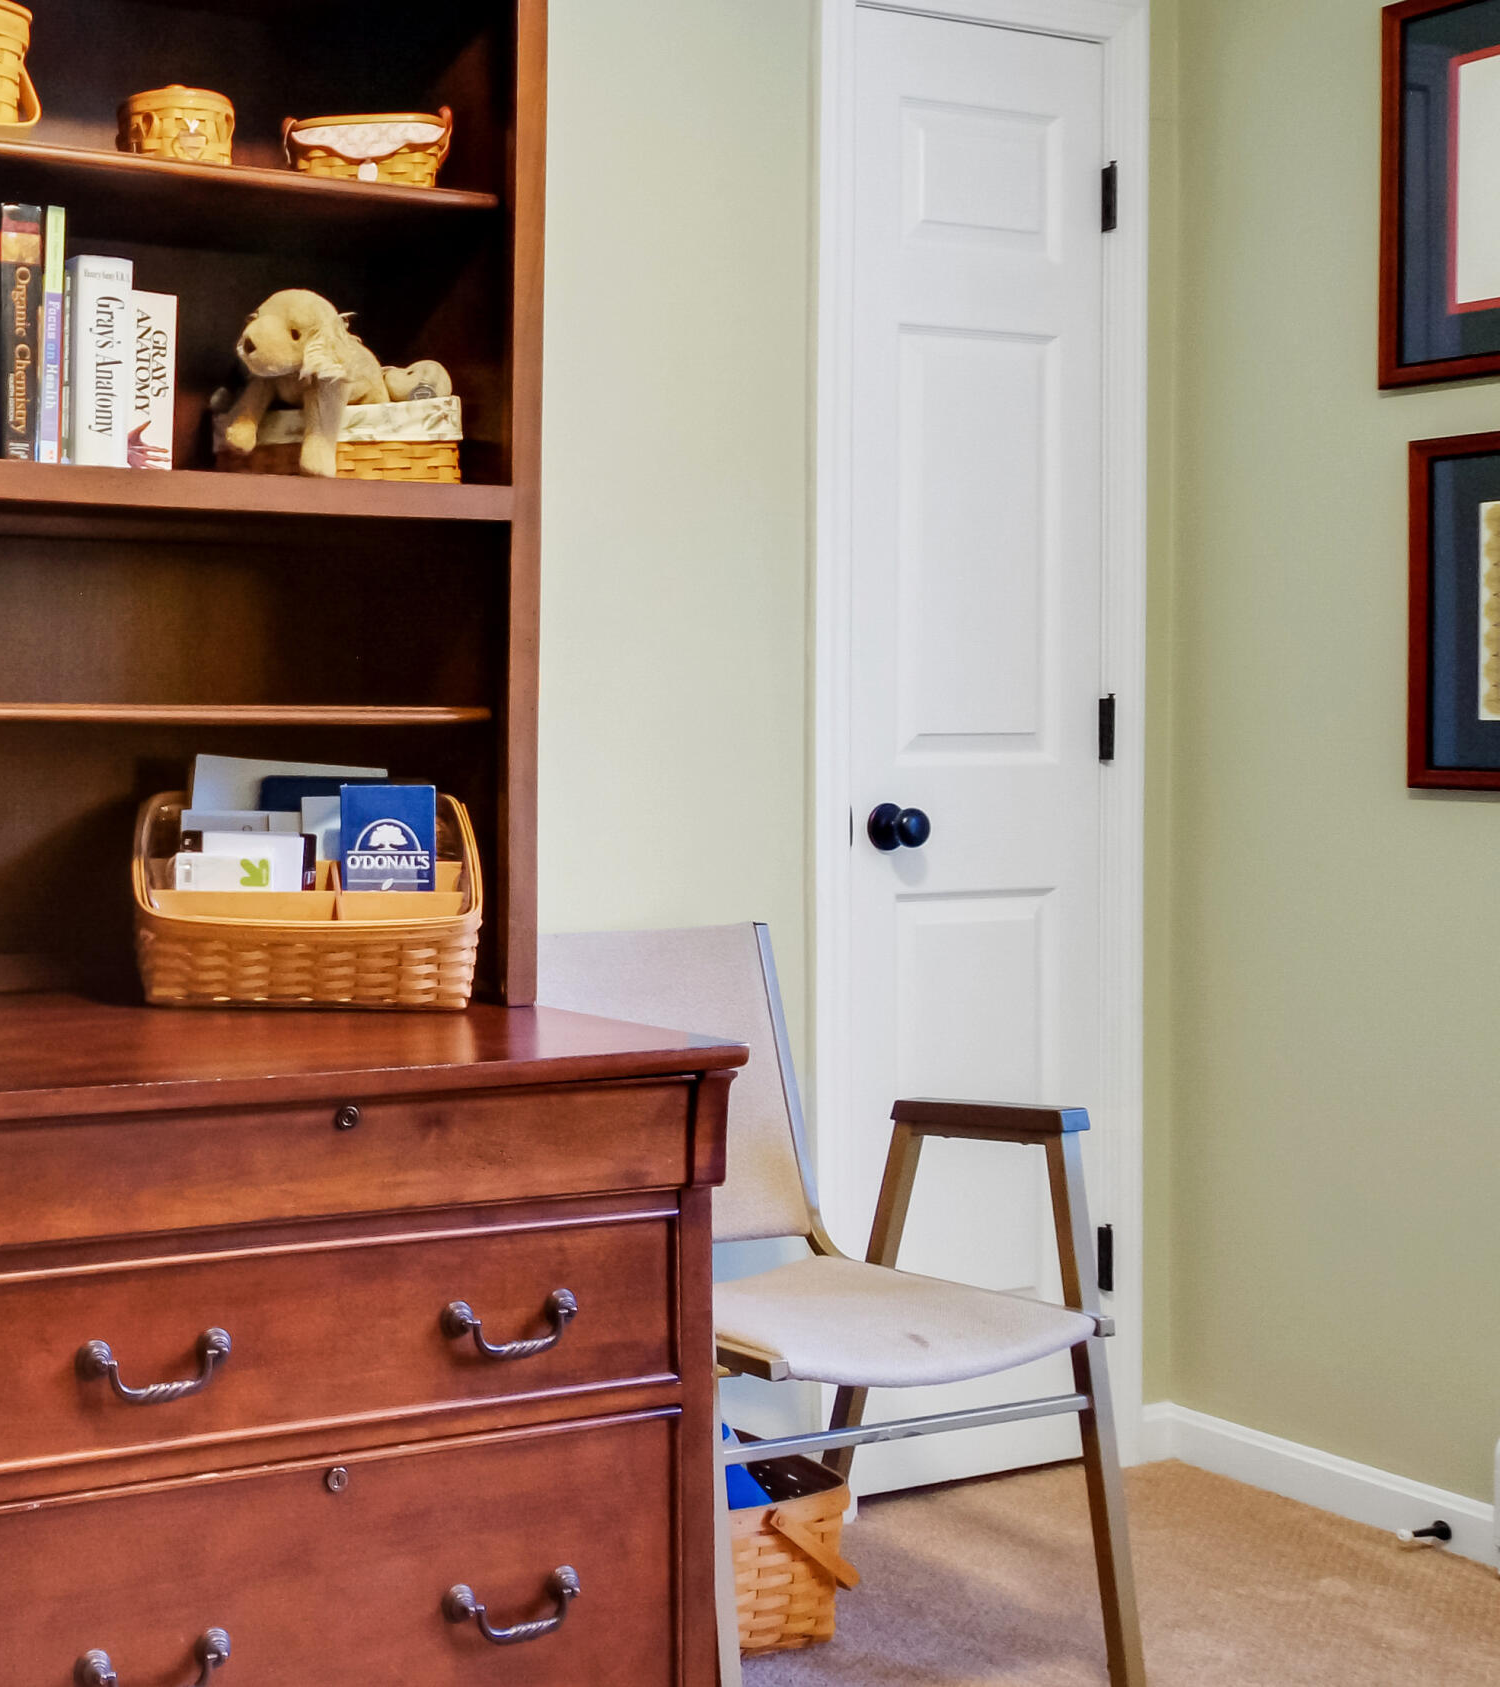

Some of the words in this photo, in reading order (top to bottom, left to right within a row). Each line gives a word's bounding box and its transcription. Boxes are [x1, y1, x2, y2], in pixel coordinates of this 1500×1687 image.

[11, 266, 32, 338] Organic
[47, 300, 61, 340] Focus
[89, 296, 125, 350] Gray's
[46, 343, 57, 360] on
[133, 308, 152, 416] ANATOMY
[150, 329, 170, 399] GRAY'S
[9, 343, 32, 435] Chemistry
[45, 363, 60, 410] Health
[88, 353, 124, 437] Anatomy
[346, 854, 431, 871] O'DONAL'S
